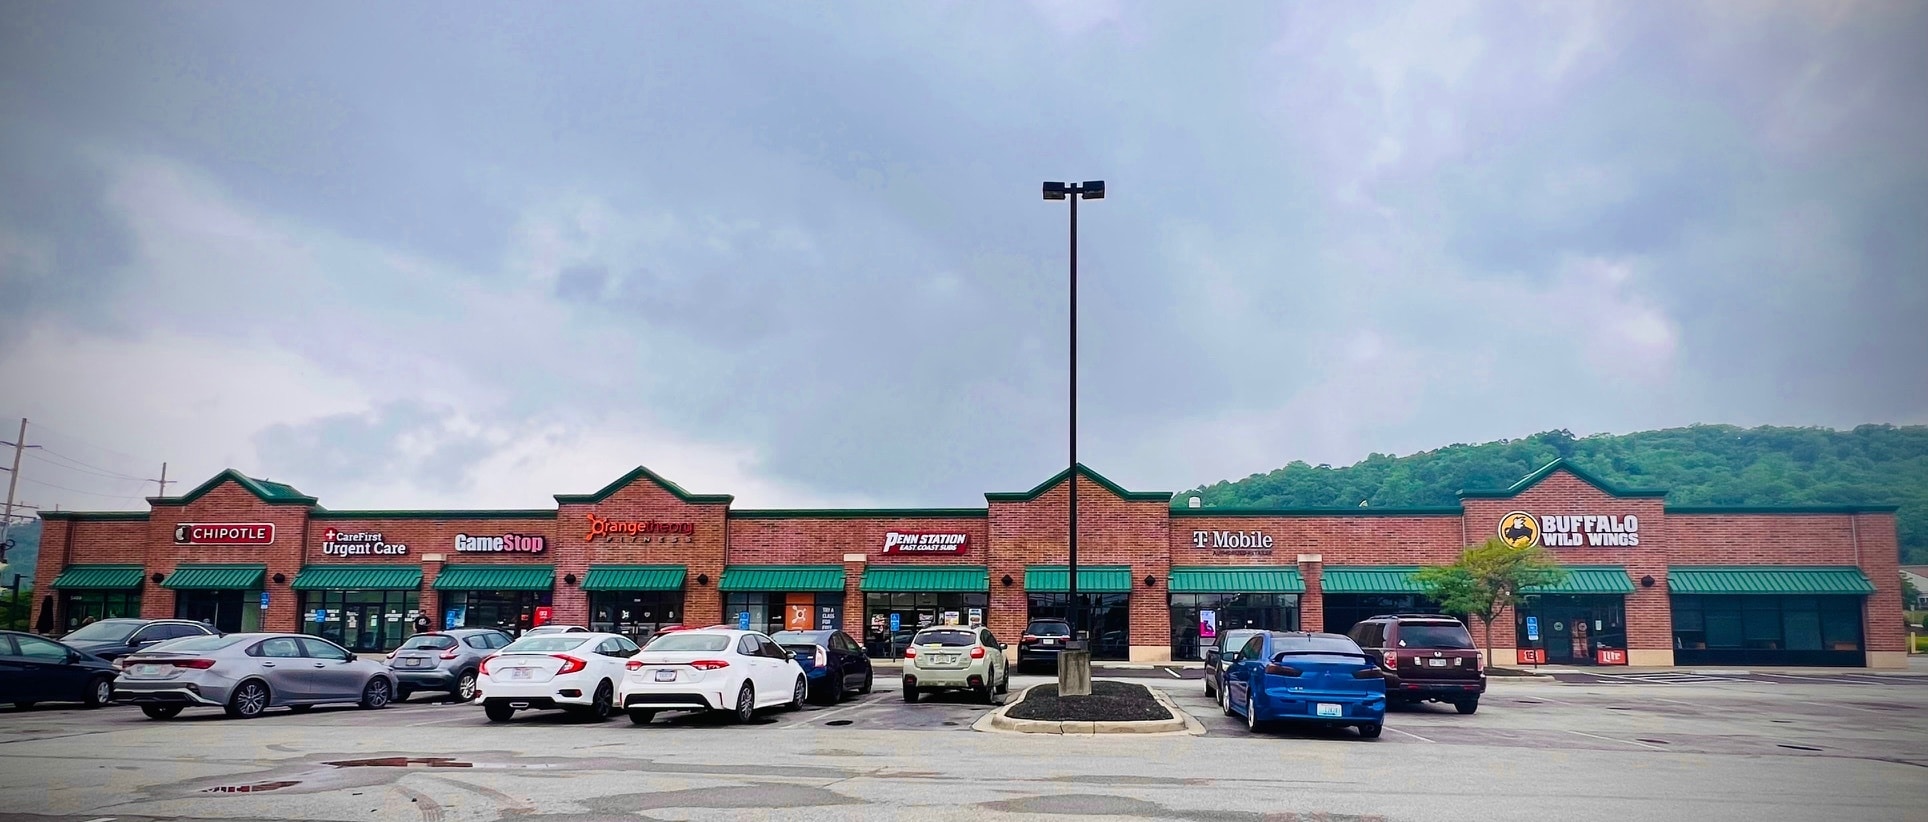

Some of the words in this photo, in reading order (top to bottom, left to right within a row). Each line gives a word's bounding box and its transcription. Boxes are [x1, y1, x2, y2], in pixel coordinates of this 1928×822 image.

[1541, 515, 1639, 533] BUFFALO
[193, 528, 266, 539] CHIPOTLE
[336, 532, 382, 541] CareFirst
[1212, 531, 1273, 548] Mobile
[1541, 532, 1583, 546] WILD
[1587, 532, 1640, 546] WINGS
[323, 542, 371, 557] Urgent
[373, 542, 406, 554] Care
[454, 533, 543, 552] GameStop
[883, 532, 919, 552] PENN
[918, 534, 966, 544] STATION
